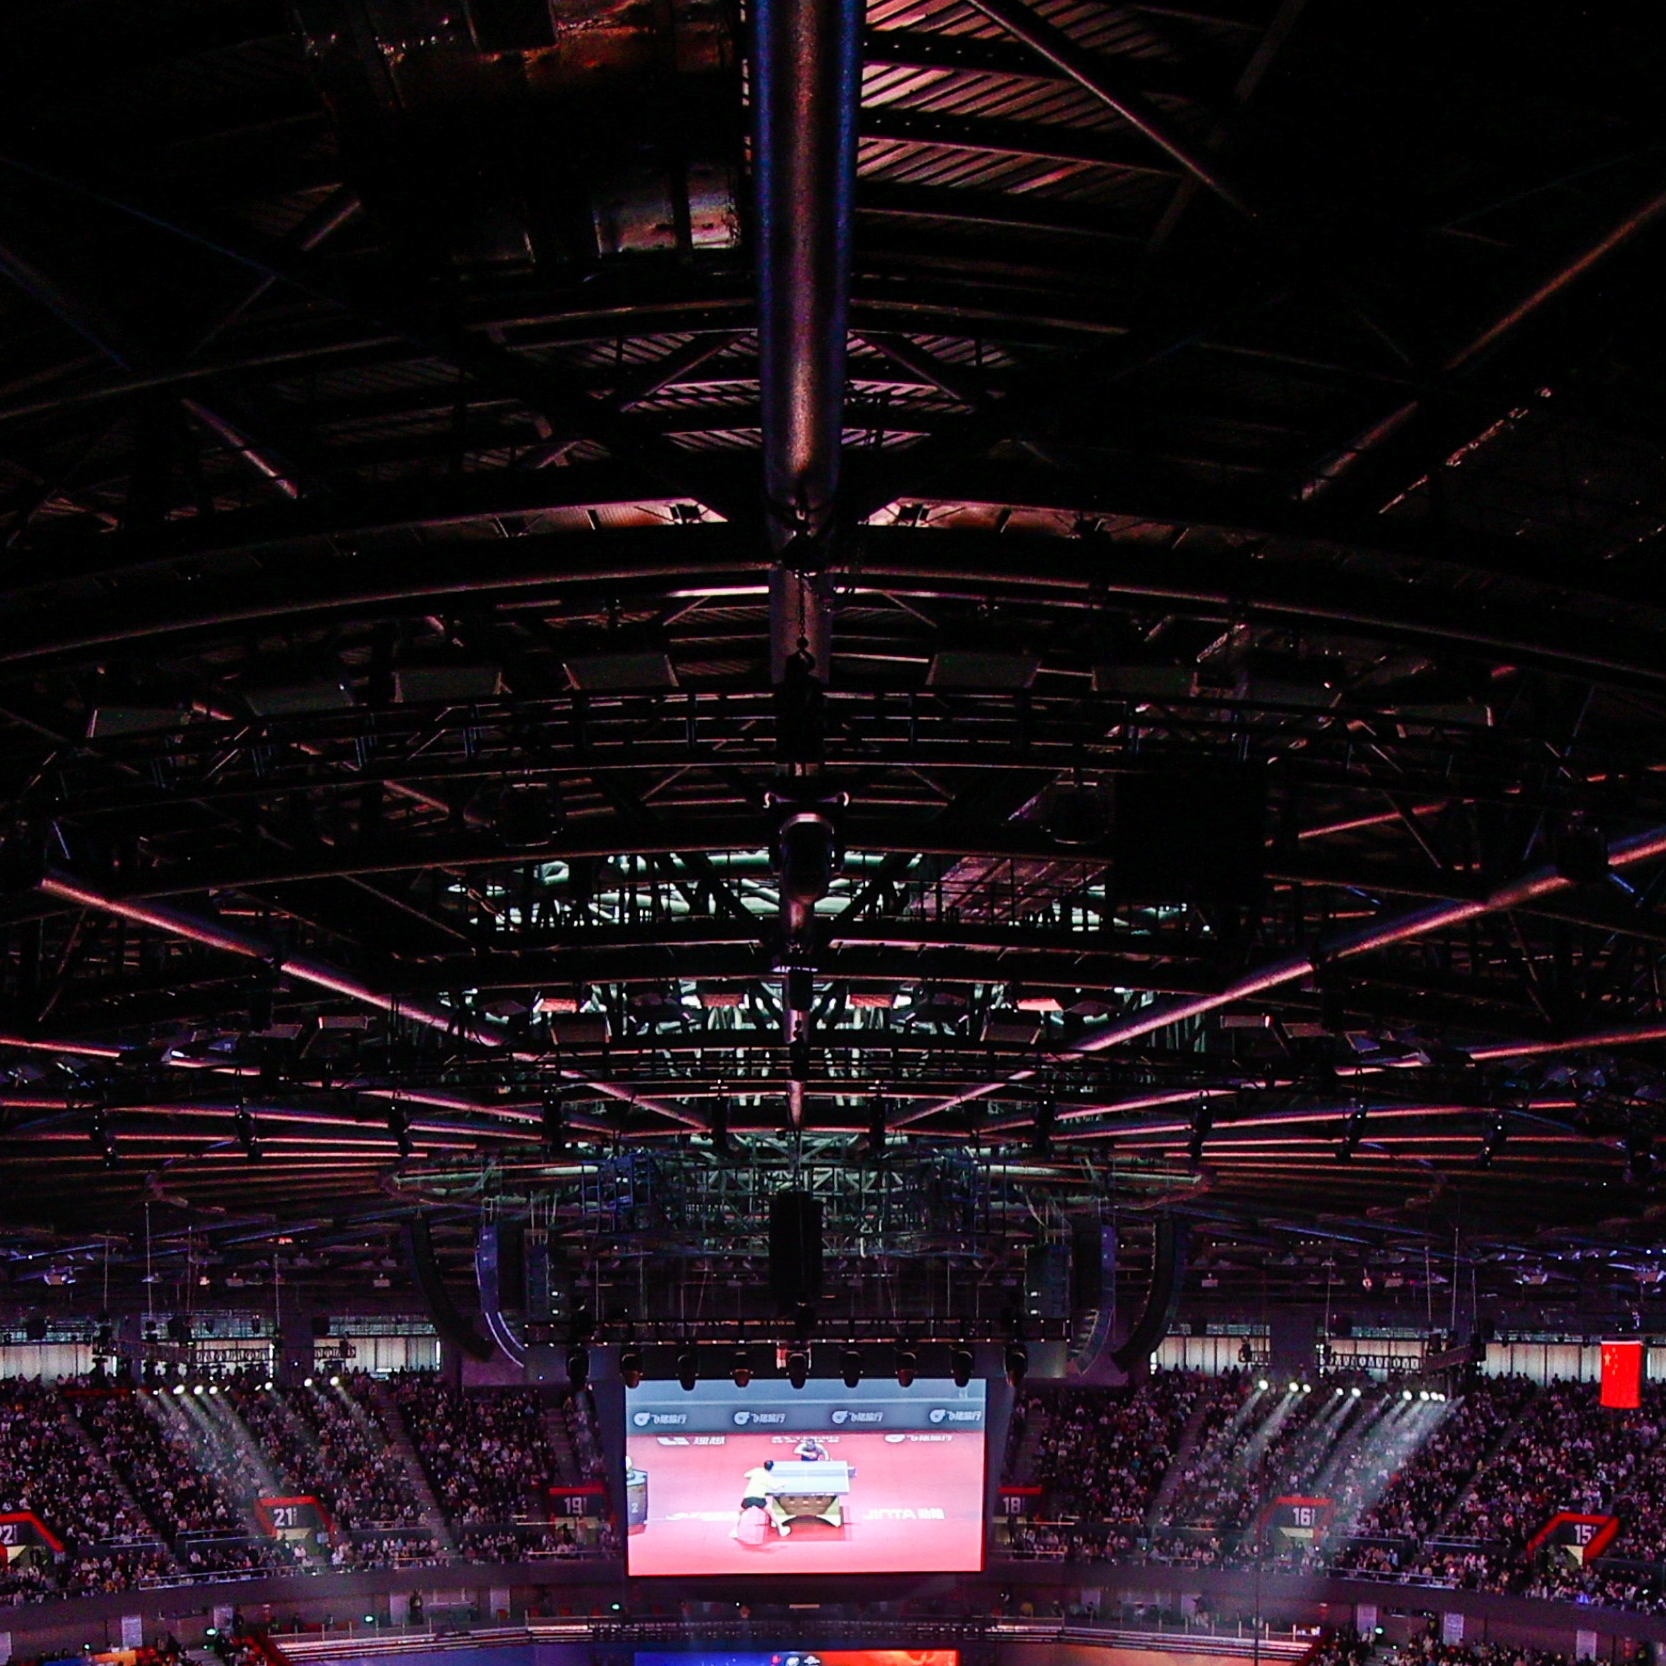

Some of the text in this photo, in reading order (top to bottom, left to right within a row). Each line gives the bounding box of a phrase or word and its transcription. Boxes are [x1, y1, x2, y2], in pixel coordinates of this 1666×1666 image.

[274, 1508, 293, 1527] 21
[1293, 1507, 1311, 1526] 16
[1574, 1524, 1592, 1544] 15
